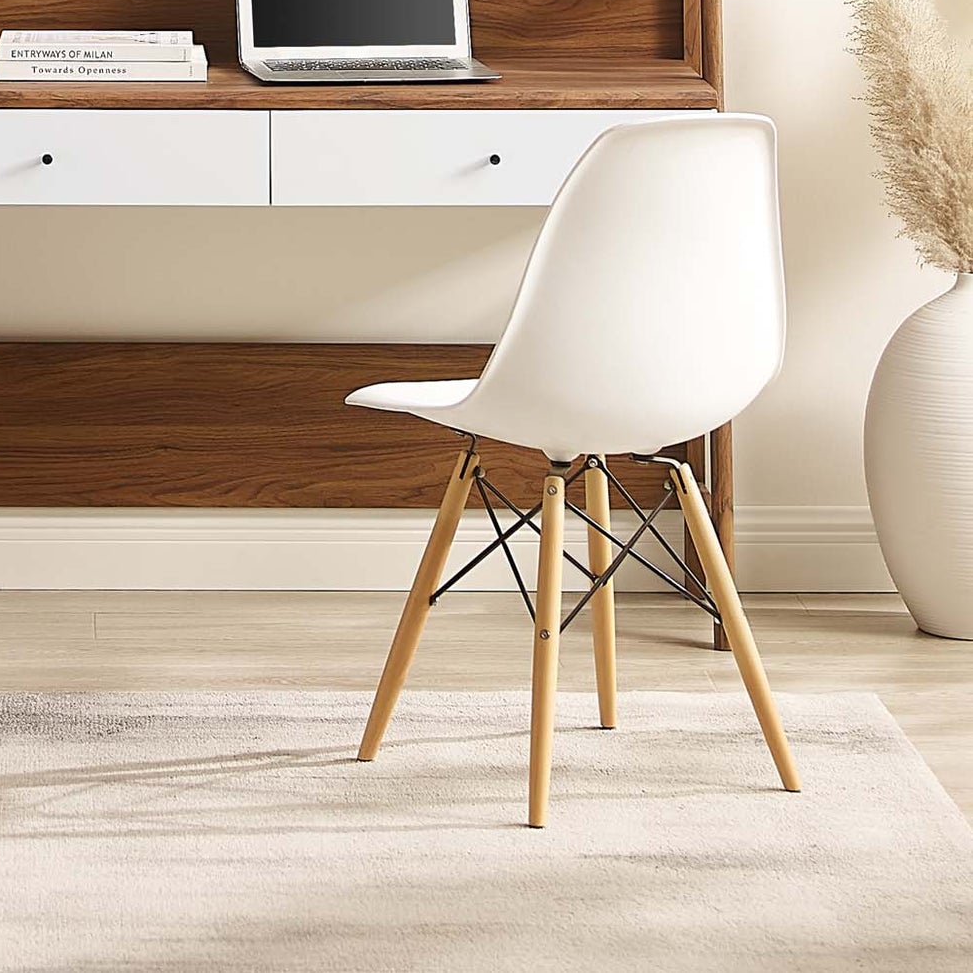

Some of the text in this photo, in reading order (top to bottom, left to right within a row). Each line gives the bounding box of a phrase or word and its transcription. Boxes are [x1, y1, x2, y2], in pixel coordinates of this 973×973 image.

[10, 49, 113, 59] ENTRYWAYS OF MILAN
[30, 65, 127, 75] Towards Openness
